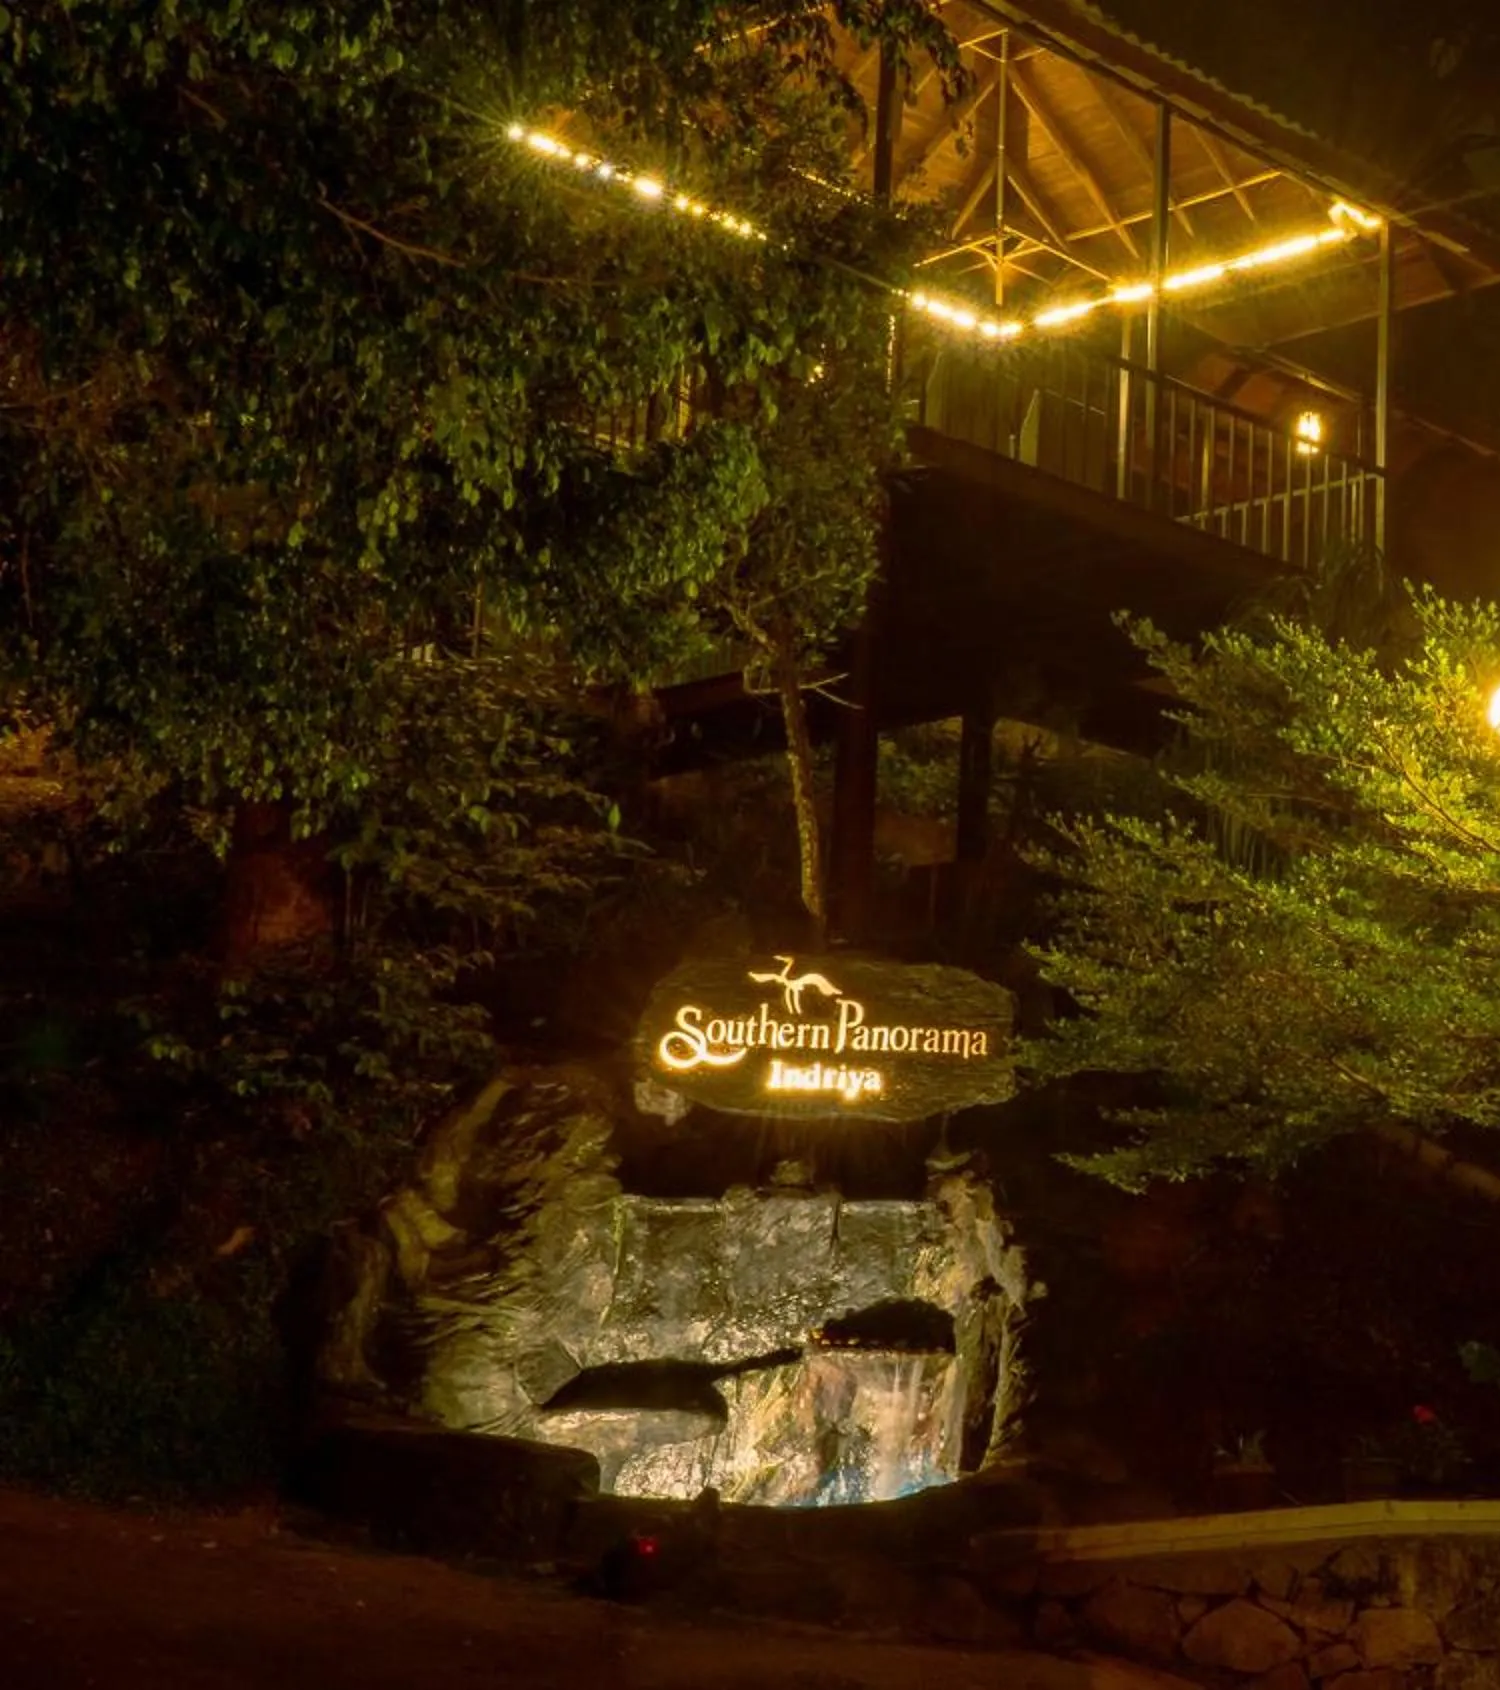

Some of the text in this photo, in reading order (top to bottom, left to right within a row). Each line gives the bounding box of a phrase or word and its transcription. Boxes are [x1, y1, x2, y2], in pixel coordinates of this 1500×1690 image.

[659, 998, 988, 1068] Southern Panorama
[767, 1061, 882, 1097] Indriya
